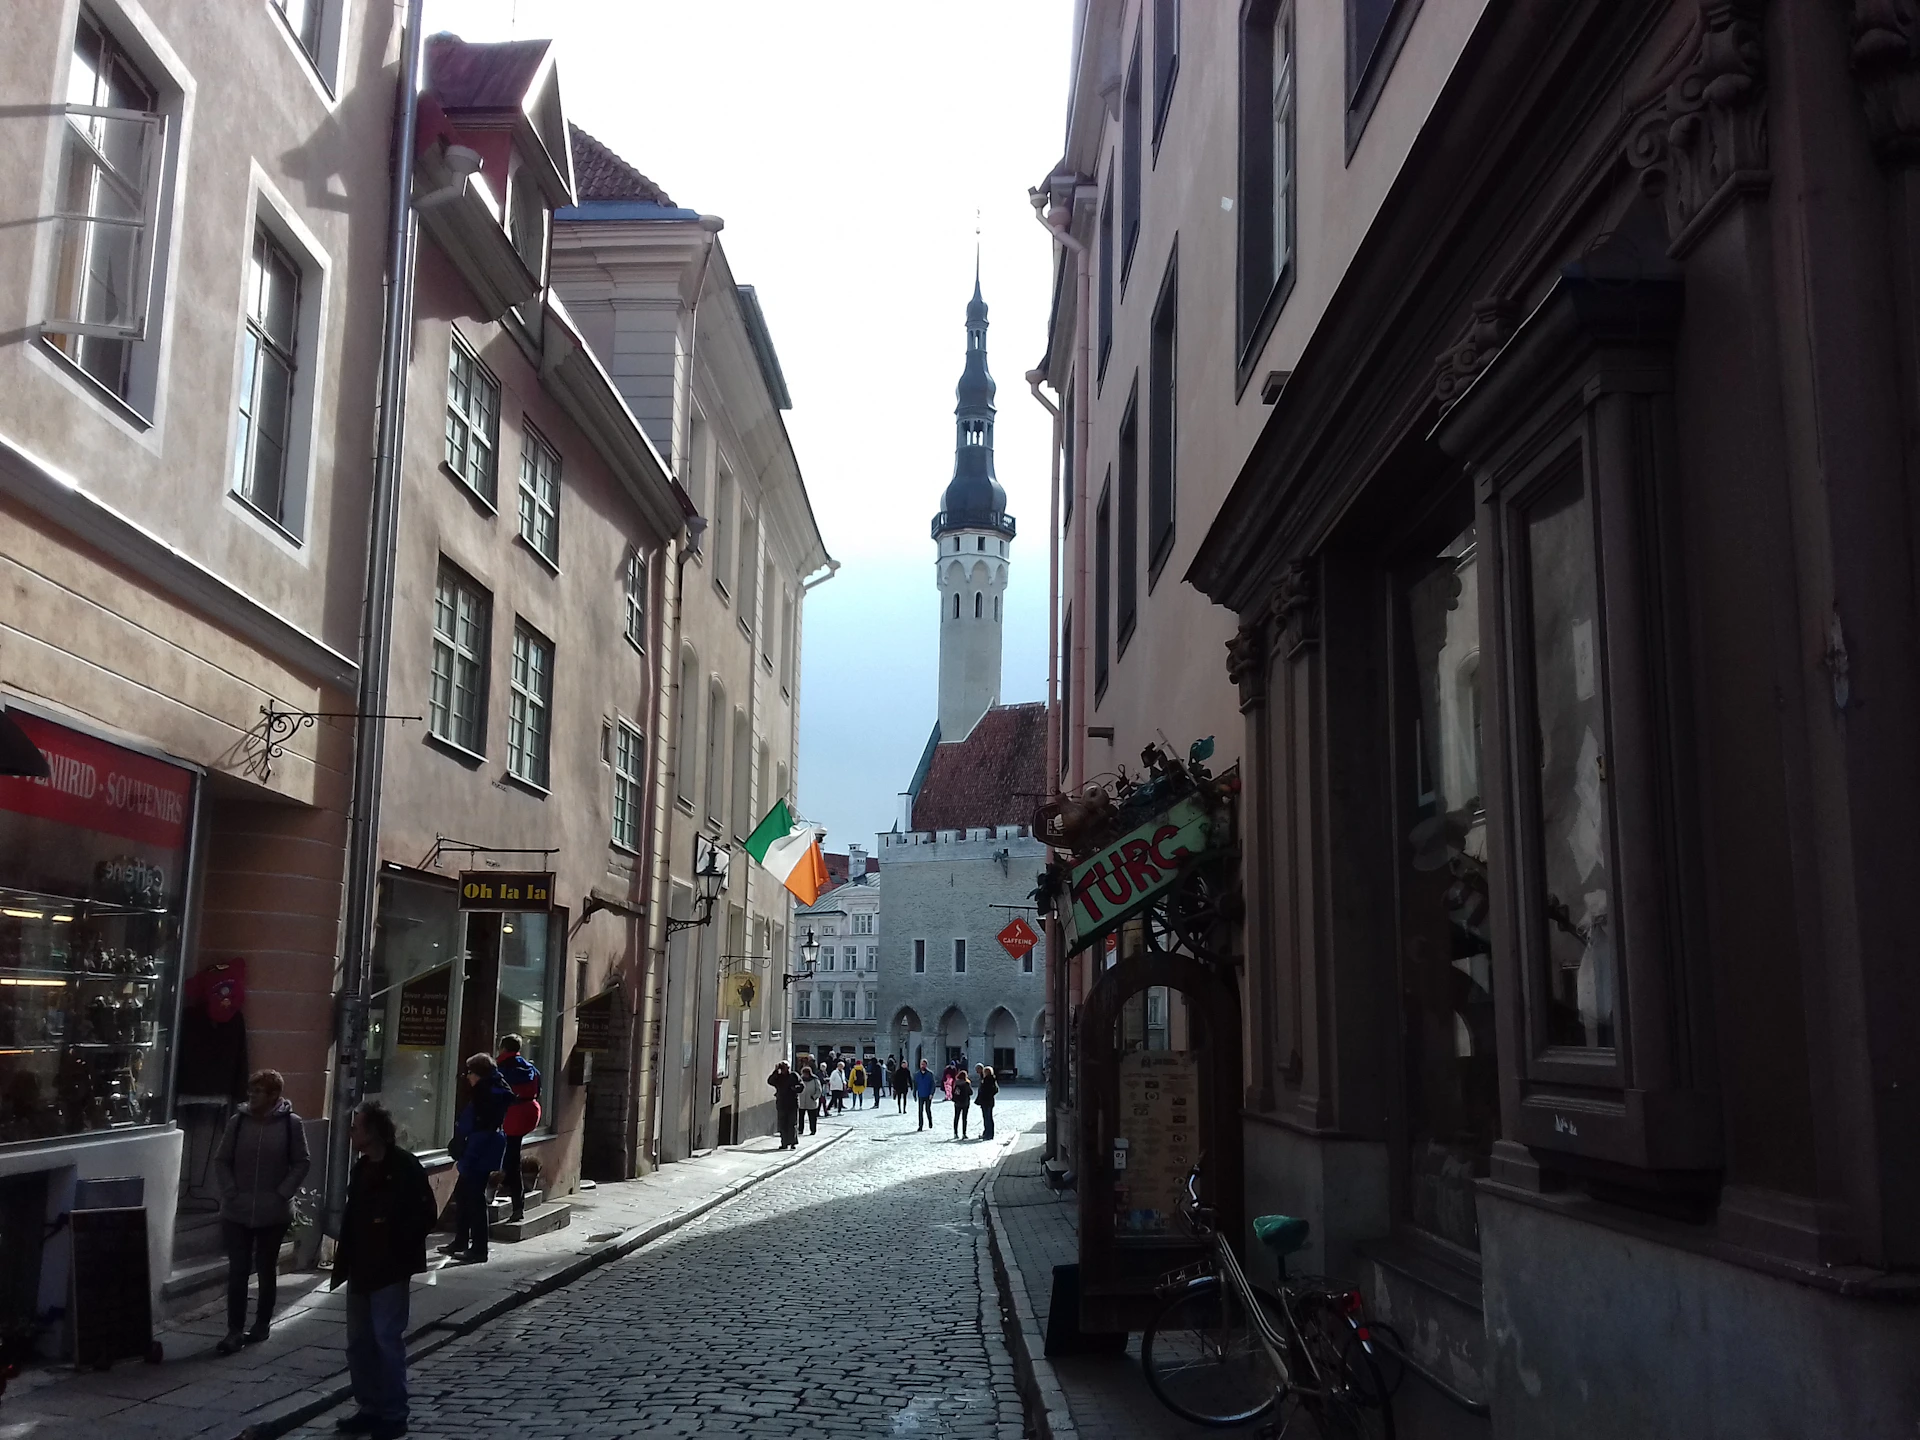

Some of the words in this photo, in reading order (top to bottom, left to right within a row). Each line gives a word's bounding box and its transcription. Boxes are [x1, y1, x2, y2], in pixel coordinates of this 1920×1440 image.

[105, 772, 183, 824] SOUVENIRS
[463, 883, 493, 899] Oh
[500, 883, 520, 900] la
[527, 884, 547, 900] la
[1002, 937, 1032, 946] CAFFEINE
[402, 1004, 418, 1015] Oh
[422, 1006, 433, 1015] la
[436, 1005, 447, 1015] la
